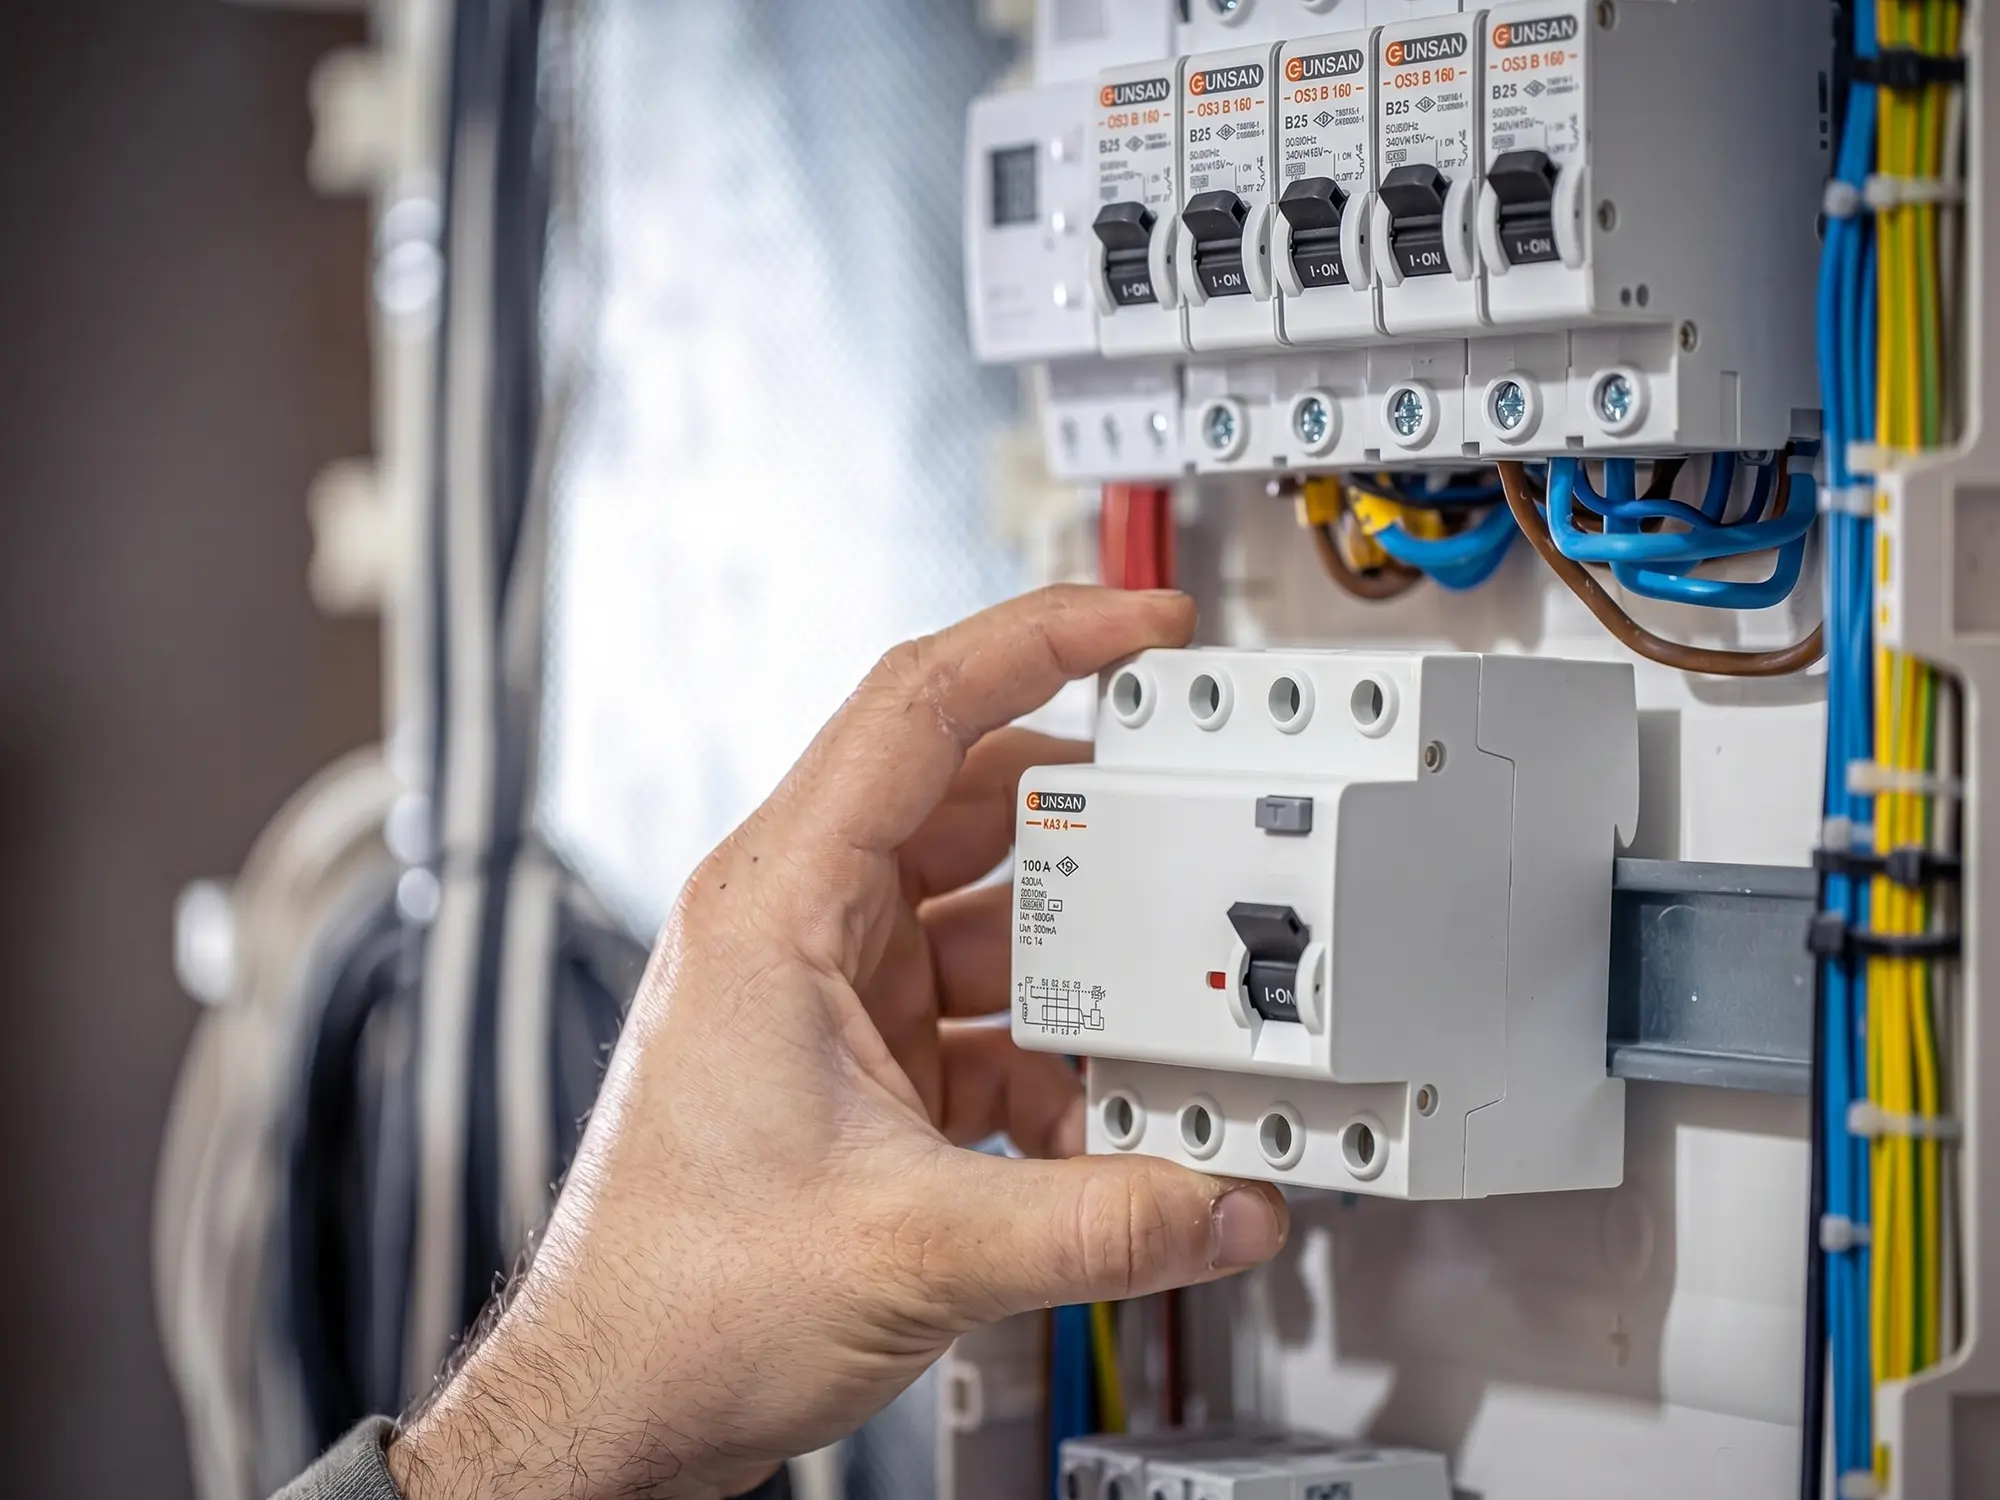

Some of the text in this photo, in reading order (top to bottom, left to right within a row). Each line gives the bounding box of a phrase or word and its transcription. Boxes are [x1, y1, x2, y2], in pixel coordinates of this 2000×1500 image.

[1494, 16, 1575, 47] GUNSAN
[1386, 35, 1465, 66] GUNSAN
[1286, 51, 1362, 81] GUNSAN
[1502, 50, 1565, 72] OS3 B 160
[1190, 66, 1262, 95] GUNSAN
[1394, 67, 1455, 89] OS3 B 160
[1100, 79, 1168, 106] GUNSAN
[1294, 83, 1351, 104] OS3 B 160
[1492, 83, 1517, 100] B25
[1197, 97, 1252, 117] OS3 B 160
[1386, 100, 1410, 116] B25
[1285, 114, 1308, 130] B25
[1190, 127, 1211, 143] B25
[1099, 138, 1120, 154] B25
[1027, 792, 1084, 812] GUNSAN
[1043, 818, 1069, 831] KA3 4
[1022, 859, 1051, 872] 100 A
